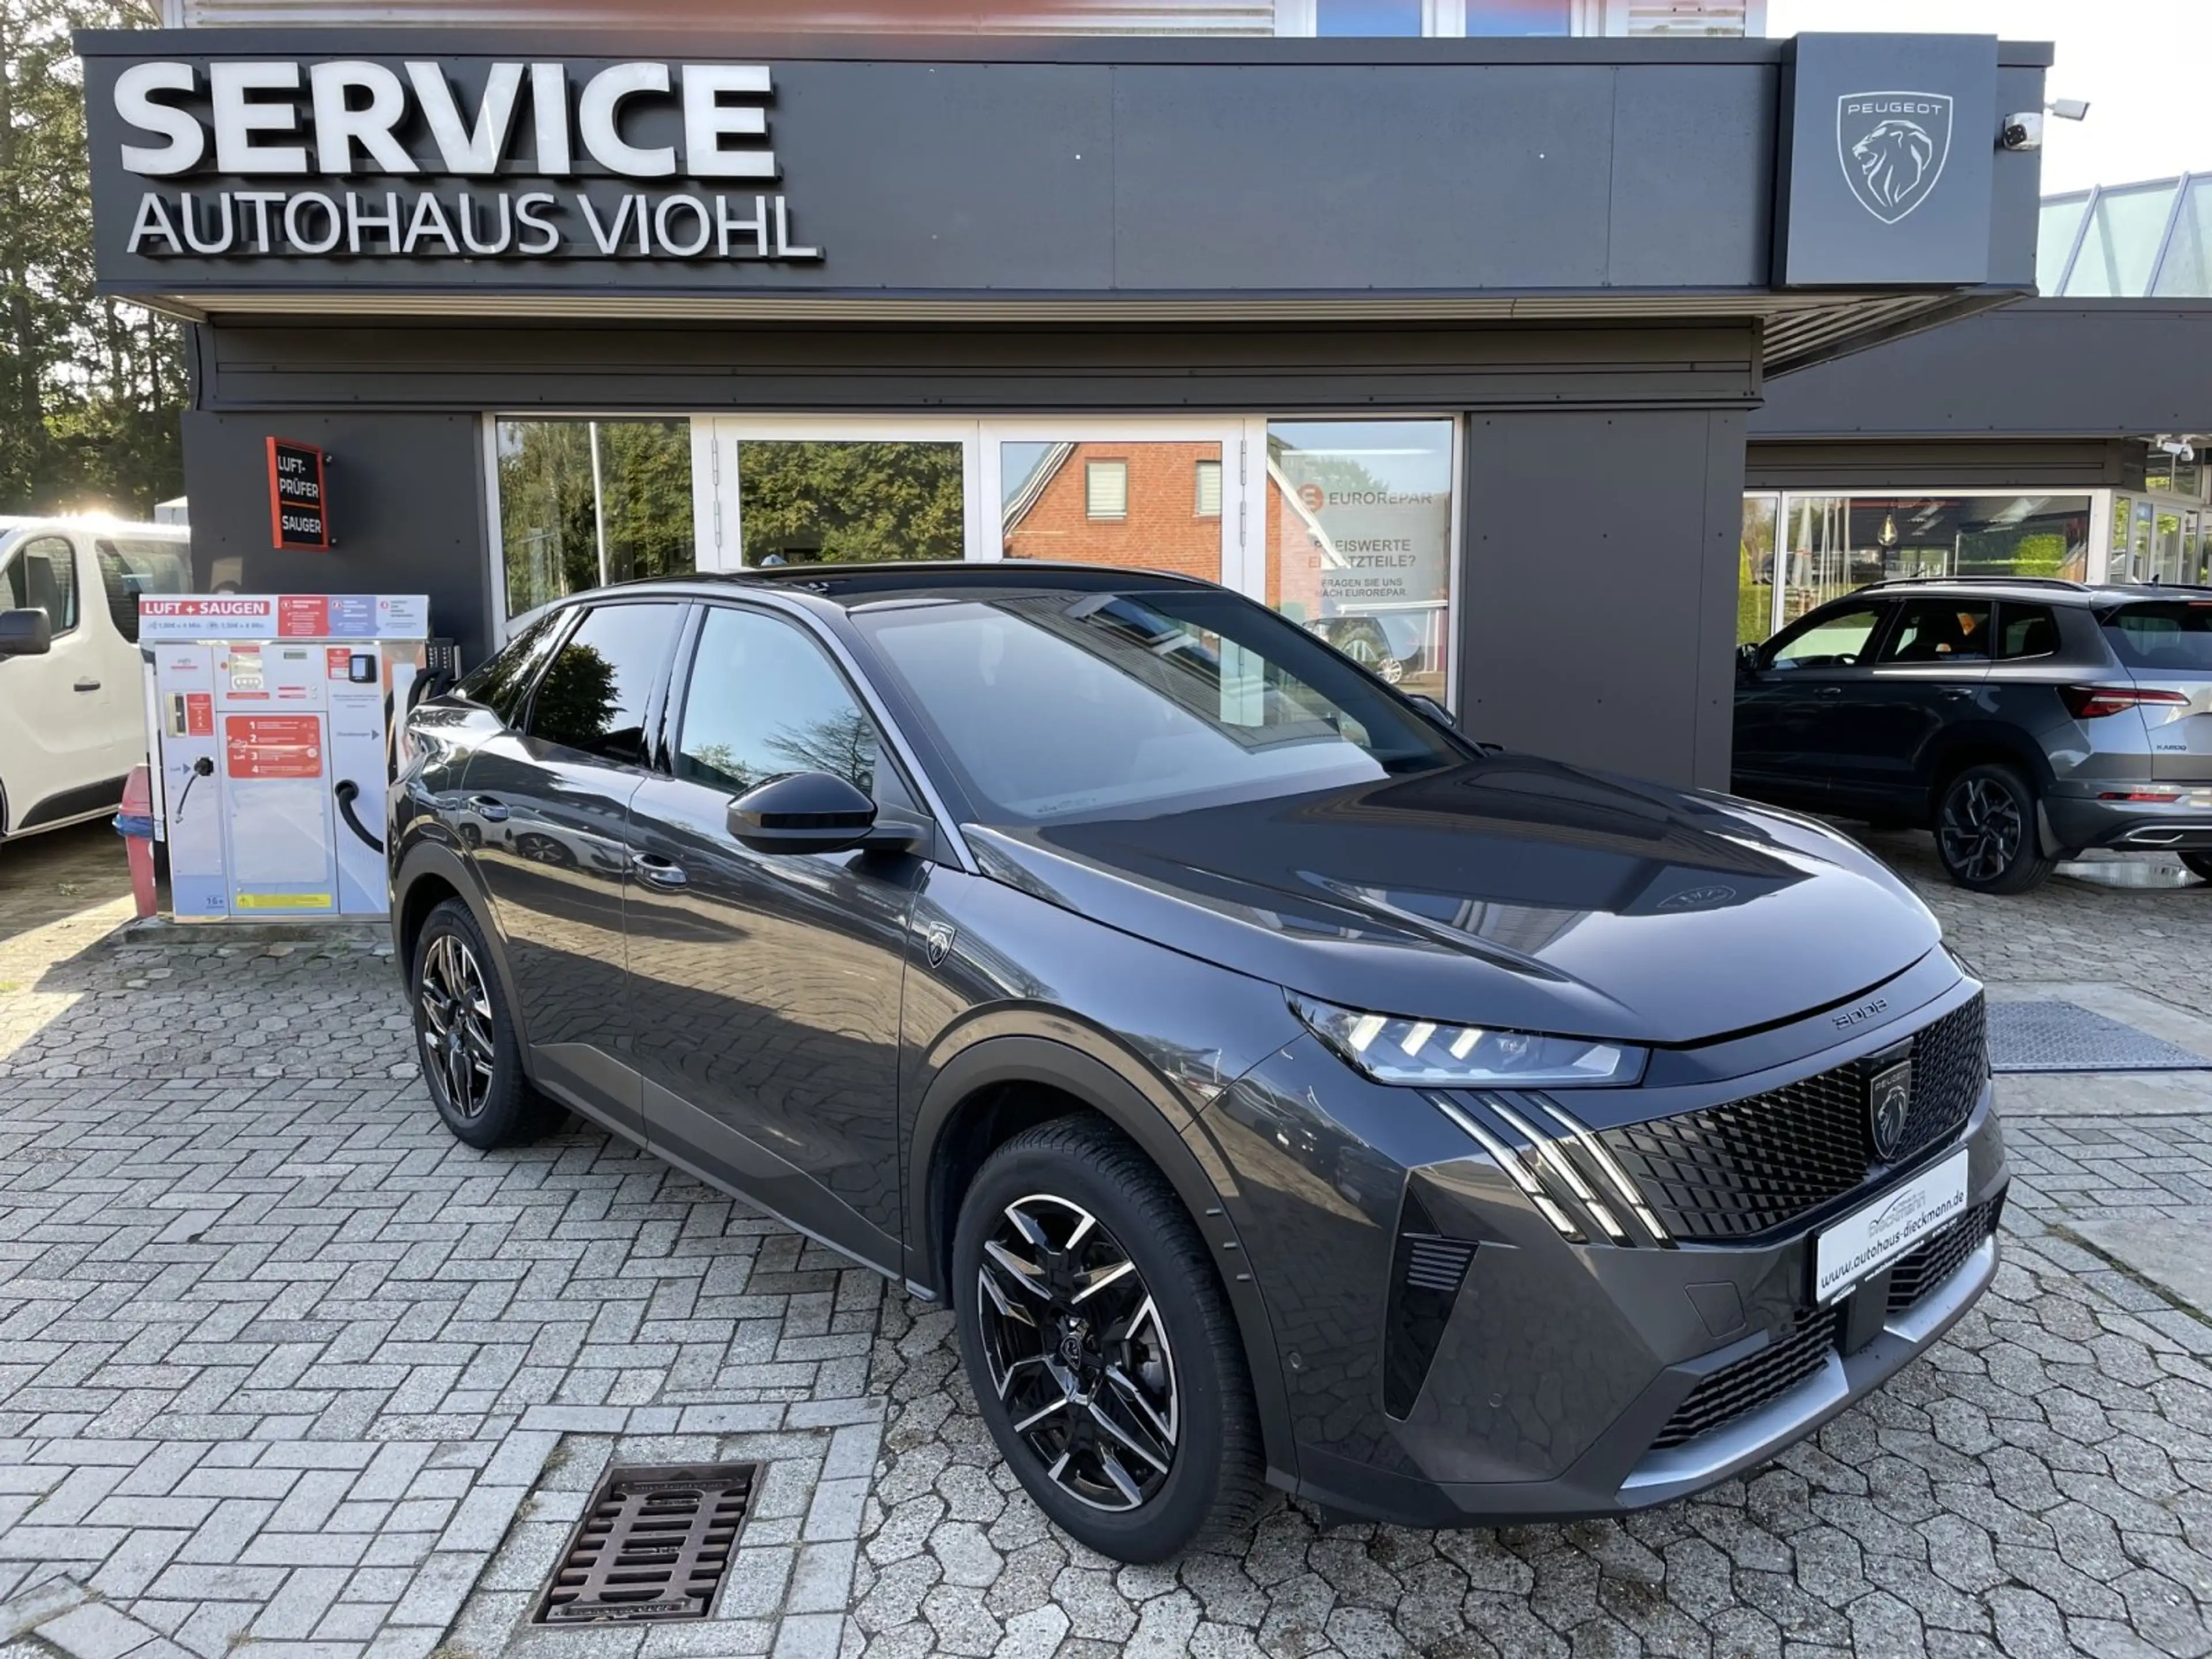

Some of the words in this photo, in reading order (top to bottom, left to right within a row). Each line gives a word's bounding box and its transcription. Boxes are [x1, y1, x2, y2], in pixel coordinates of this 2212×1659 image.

[1847, 102, 1943, 115] PEUGEOT
[113, 60, 775, 176] SERVICE
[126, 191, 560, 254] AUTOHAUS
[576, 194, 817, 257] VIOHL
[278, 455, 306, 474] LUFT-
[279, 478, 319, 498] PRÜFER
[1329, 491, 1433, 505] EUROREPAR
[282, 515, 322, 533] SAUGER
[1314, 539, 1411, 552] PEISWERTE
[1321, 578, 1361, 588] FRAGEN
[1364, 578, 1380, 587] SIE
[1382, 578, 1403, 586] UNS
[145, 602, 182, 614] LUFT
[199, 602, 264, 614] SAUGEN
[249, 721, 256, 730] 1
[249, 734, 257, 743] 2
[251, 752, 258, 761] 3
[251, 764, 259, 774] 4
[1820, 1190, 1964, 1289] www.autohaus-dieckmann.de
